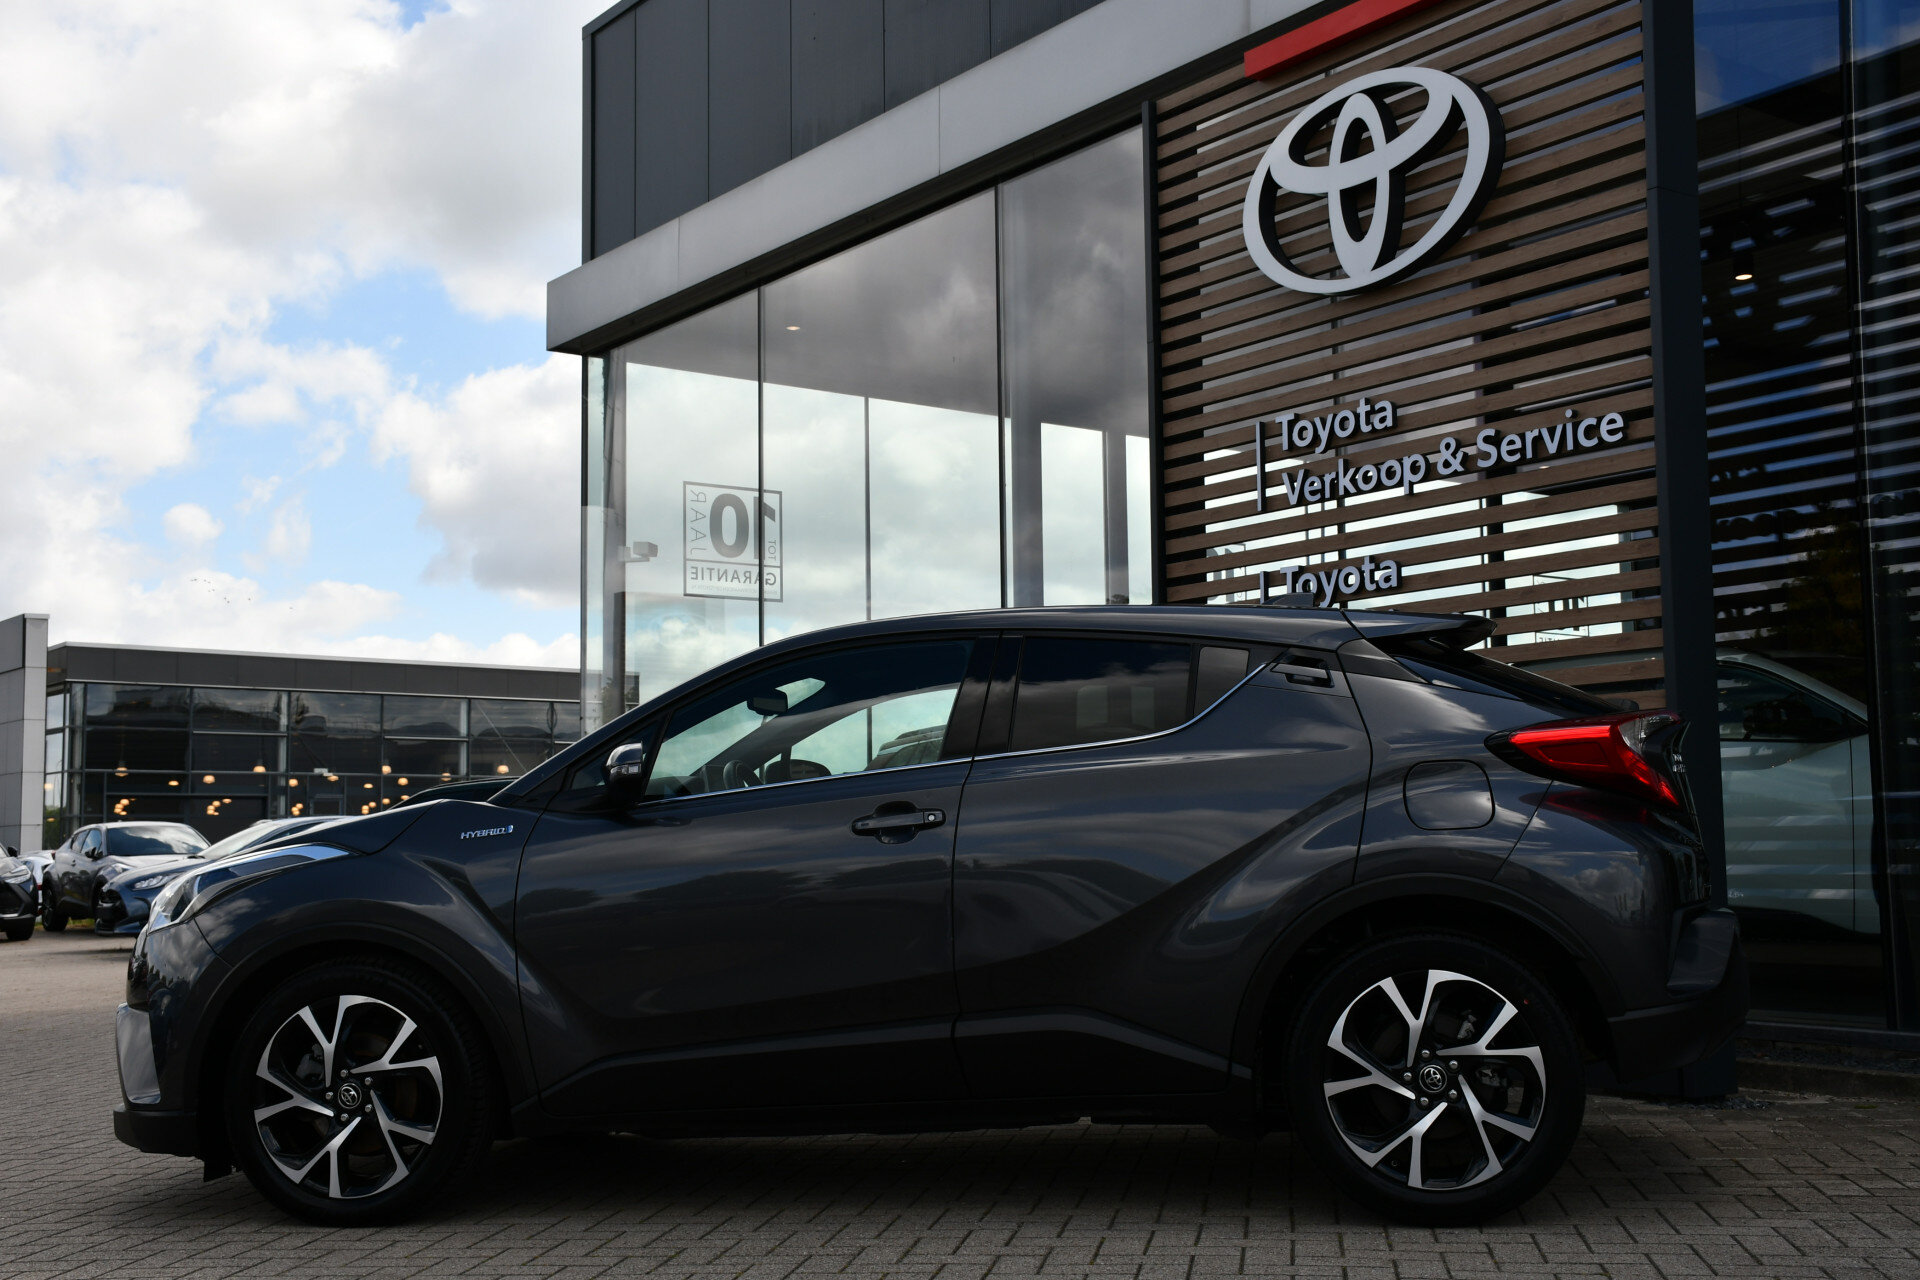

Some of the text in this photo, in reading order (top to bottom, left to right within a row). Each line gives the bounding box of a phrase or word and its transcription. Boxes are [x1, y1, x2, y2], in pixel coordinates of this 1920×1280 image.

[1276, 397, 1394, 454] Toyota
[1282, 409, 1624, 505] Verkoop & Service
[1280, 555, 1398, 608] Toyota
[461, 827, 505, 839] HYBRID
